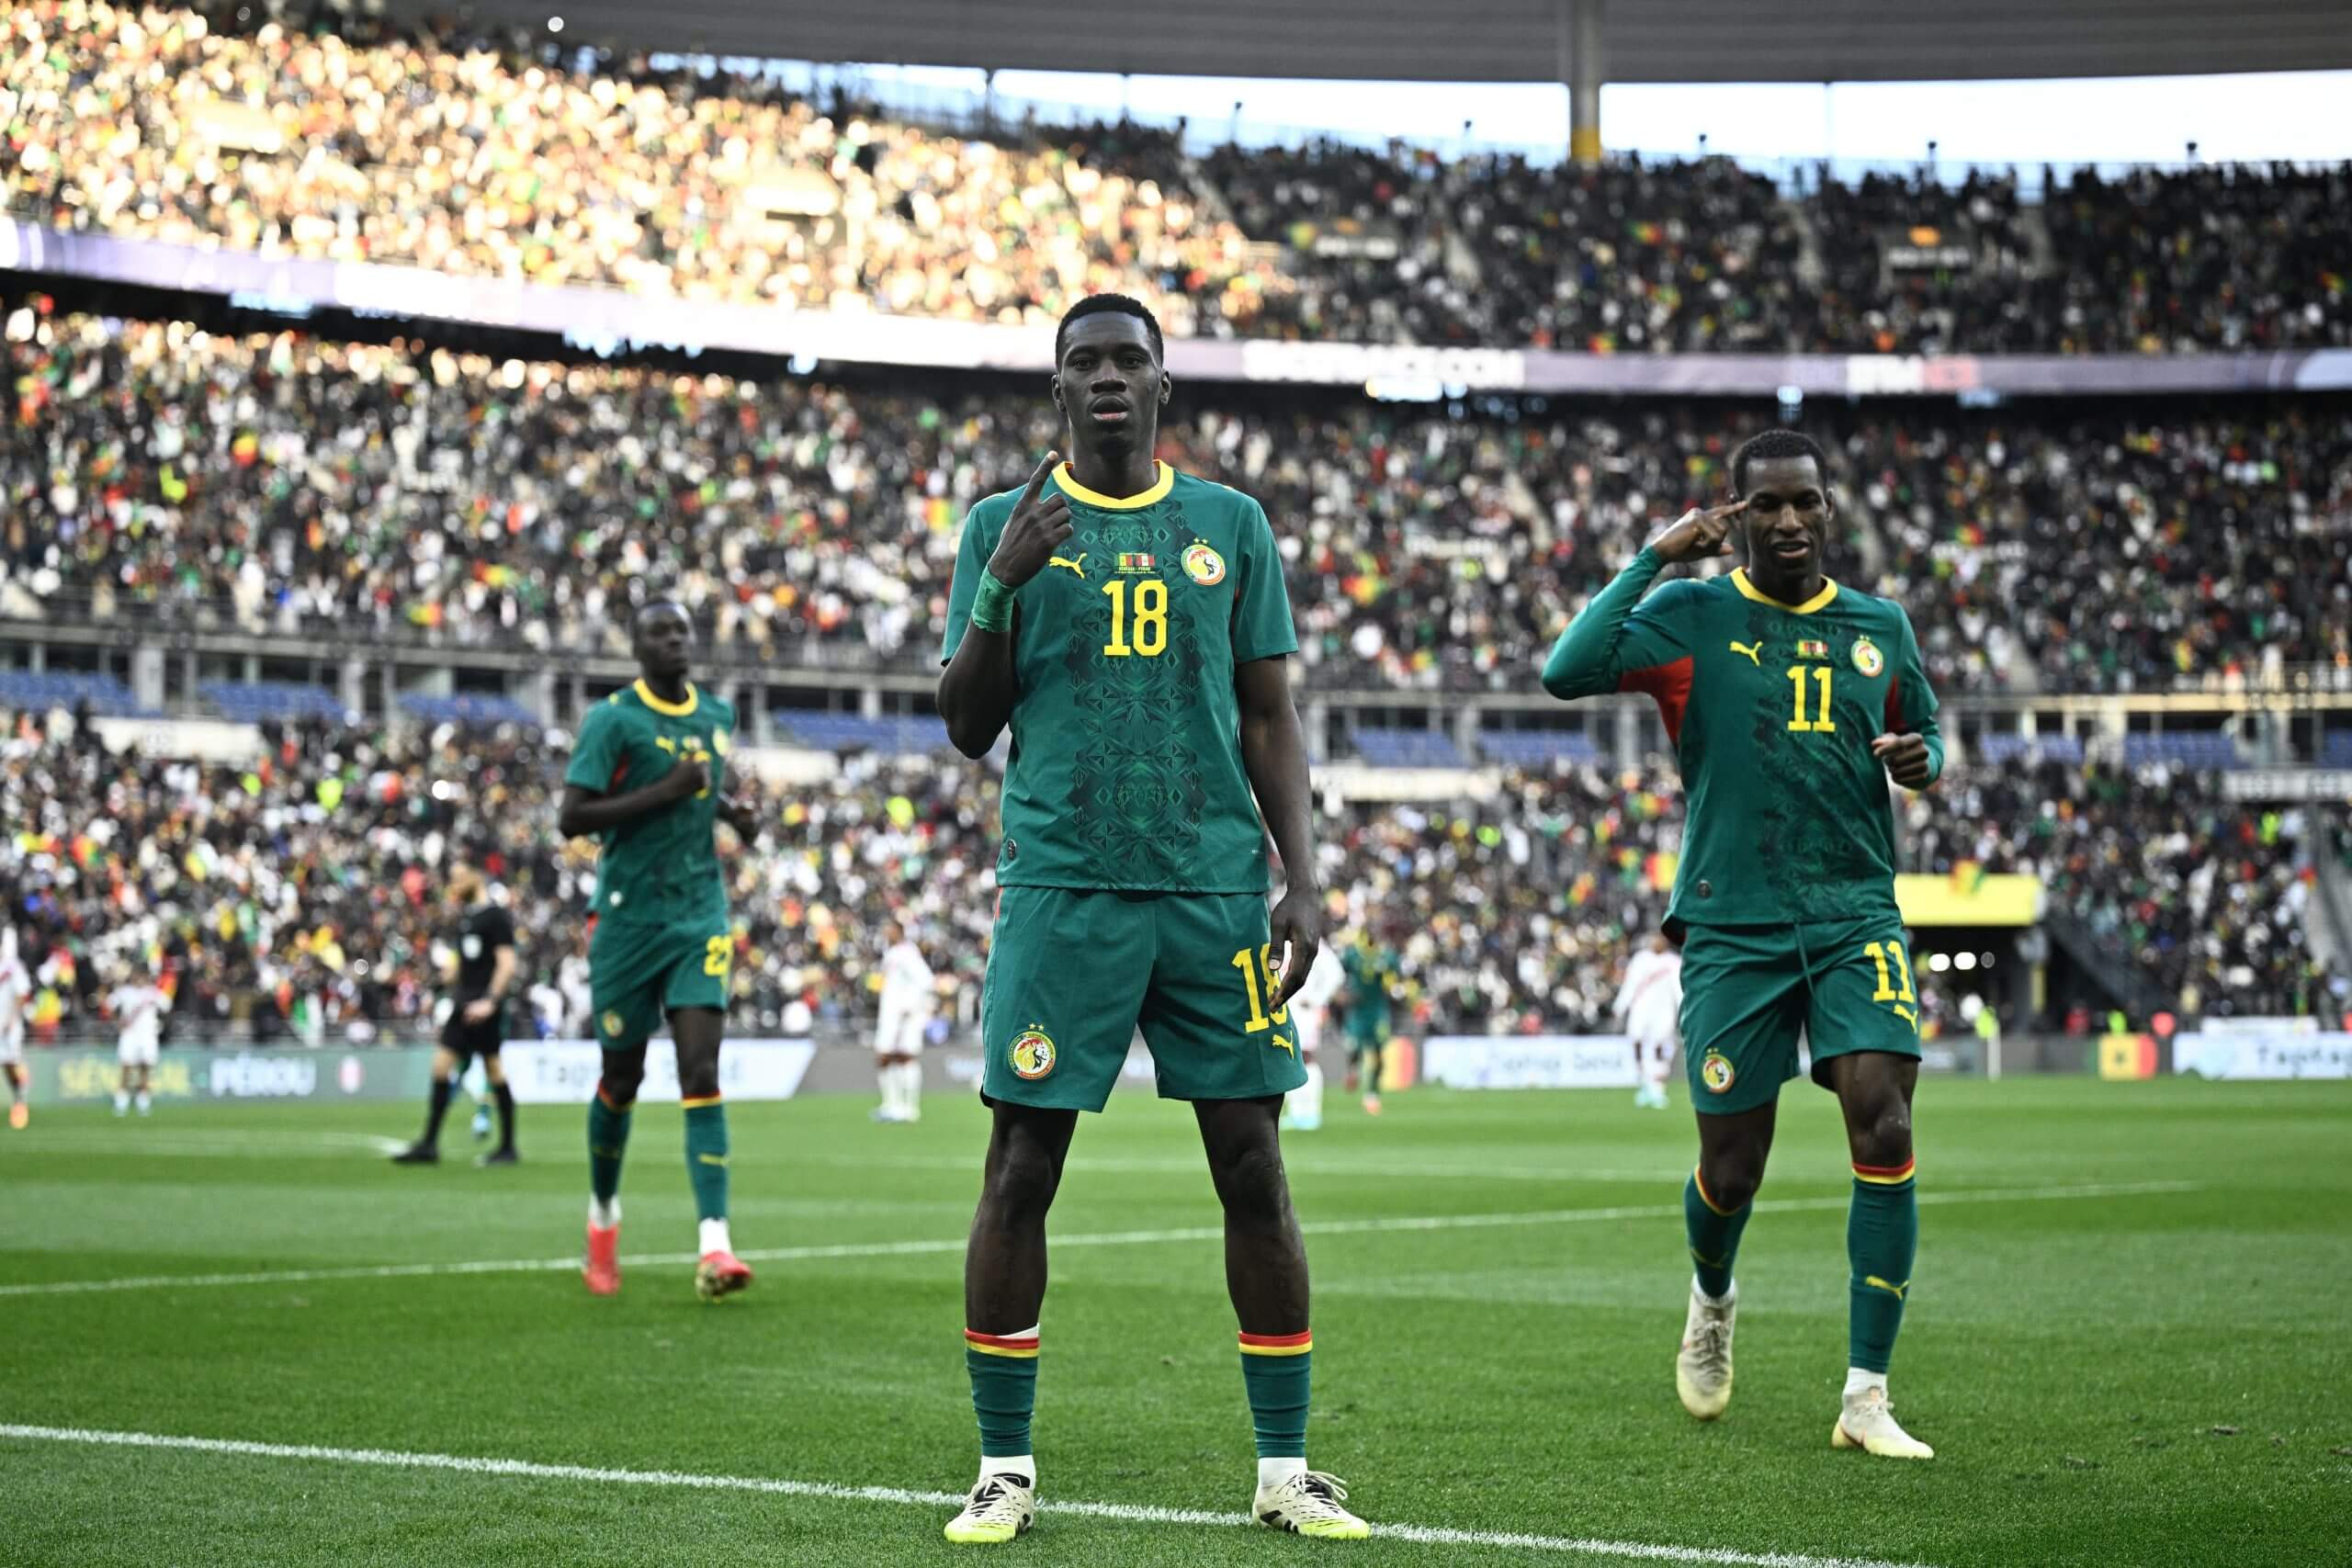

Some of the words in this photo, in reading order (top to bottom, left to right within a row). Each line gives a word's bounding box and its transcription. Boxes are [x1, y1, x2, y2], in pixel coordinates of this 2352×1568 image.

[1102, 579, 1168, 657] 18
[1786, 665, 1836, 732] 11
[1863, 941, 1915, 1003] 11
[210, 1052, 315, 1096] PÉROU
